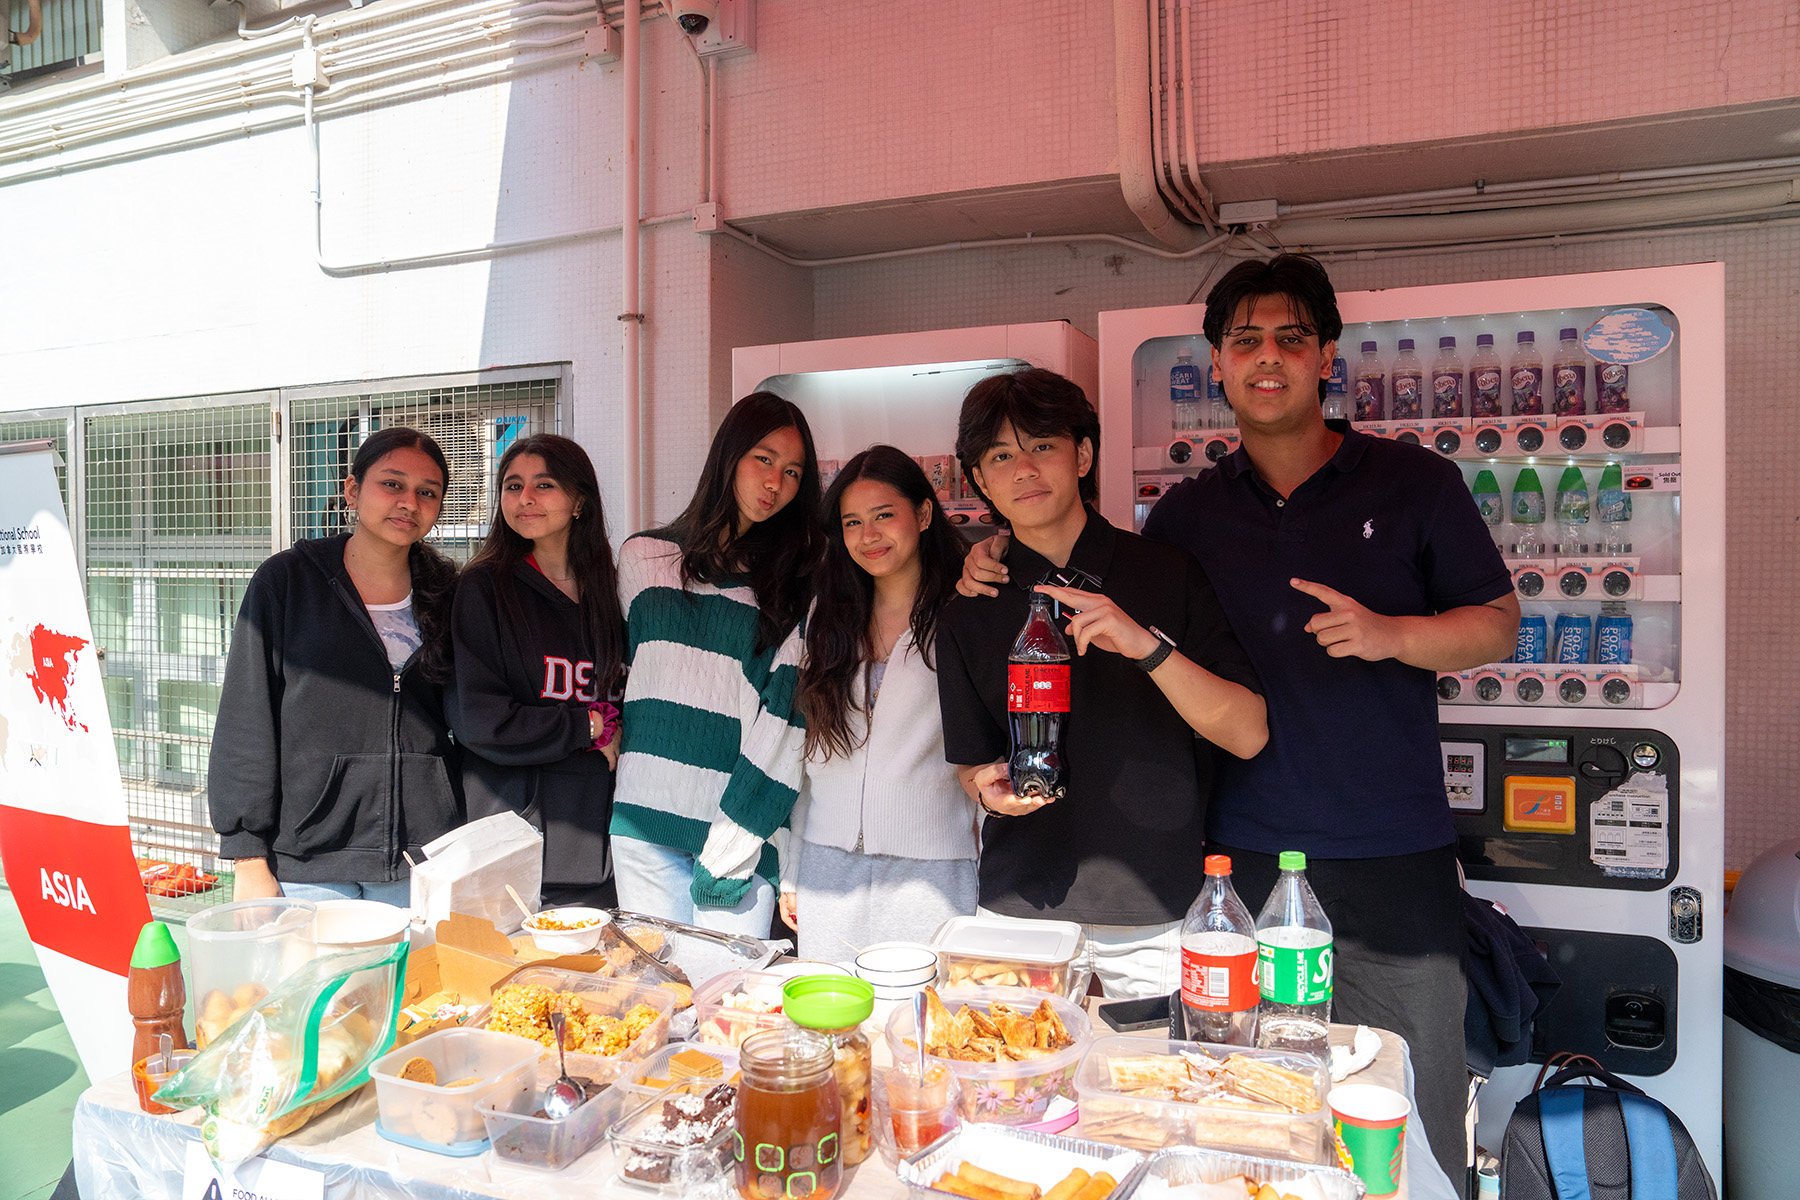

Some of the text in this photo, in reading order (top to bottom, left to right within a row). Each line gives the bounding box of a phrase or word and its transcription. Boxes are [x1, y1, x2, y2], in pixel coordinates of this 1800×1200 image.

[495, 415, 527, 424] DAIKIN
[17, 526, 40, 540] School
[1590, 737, 1617, 745] とりけし
[40, 867, 97, 915] ASIA
[1297, 965, 1305, 1002] RECYCLE
